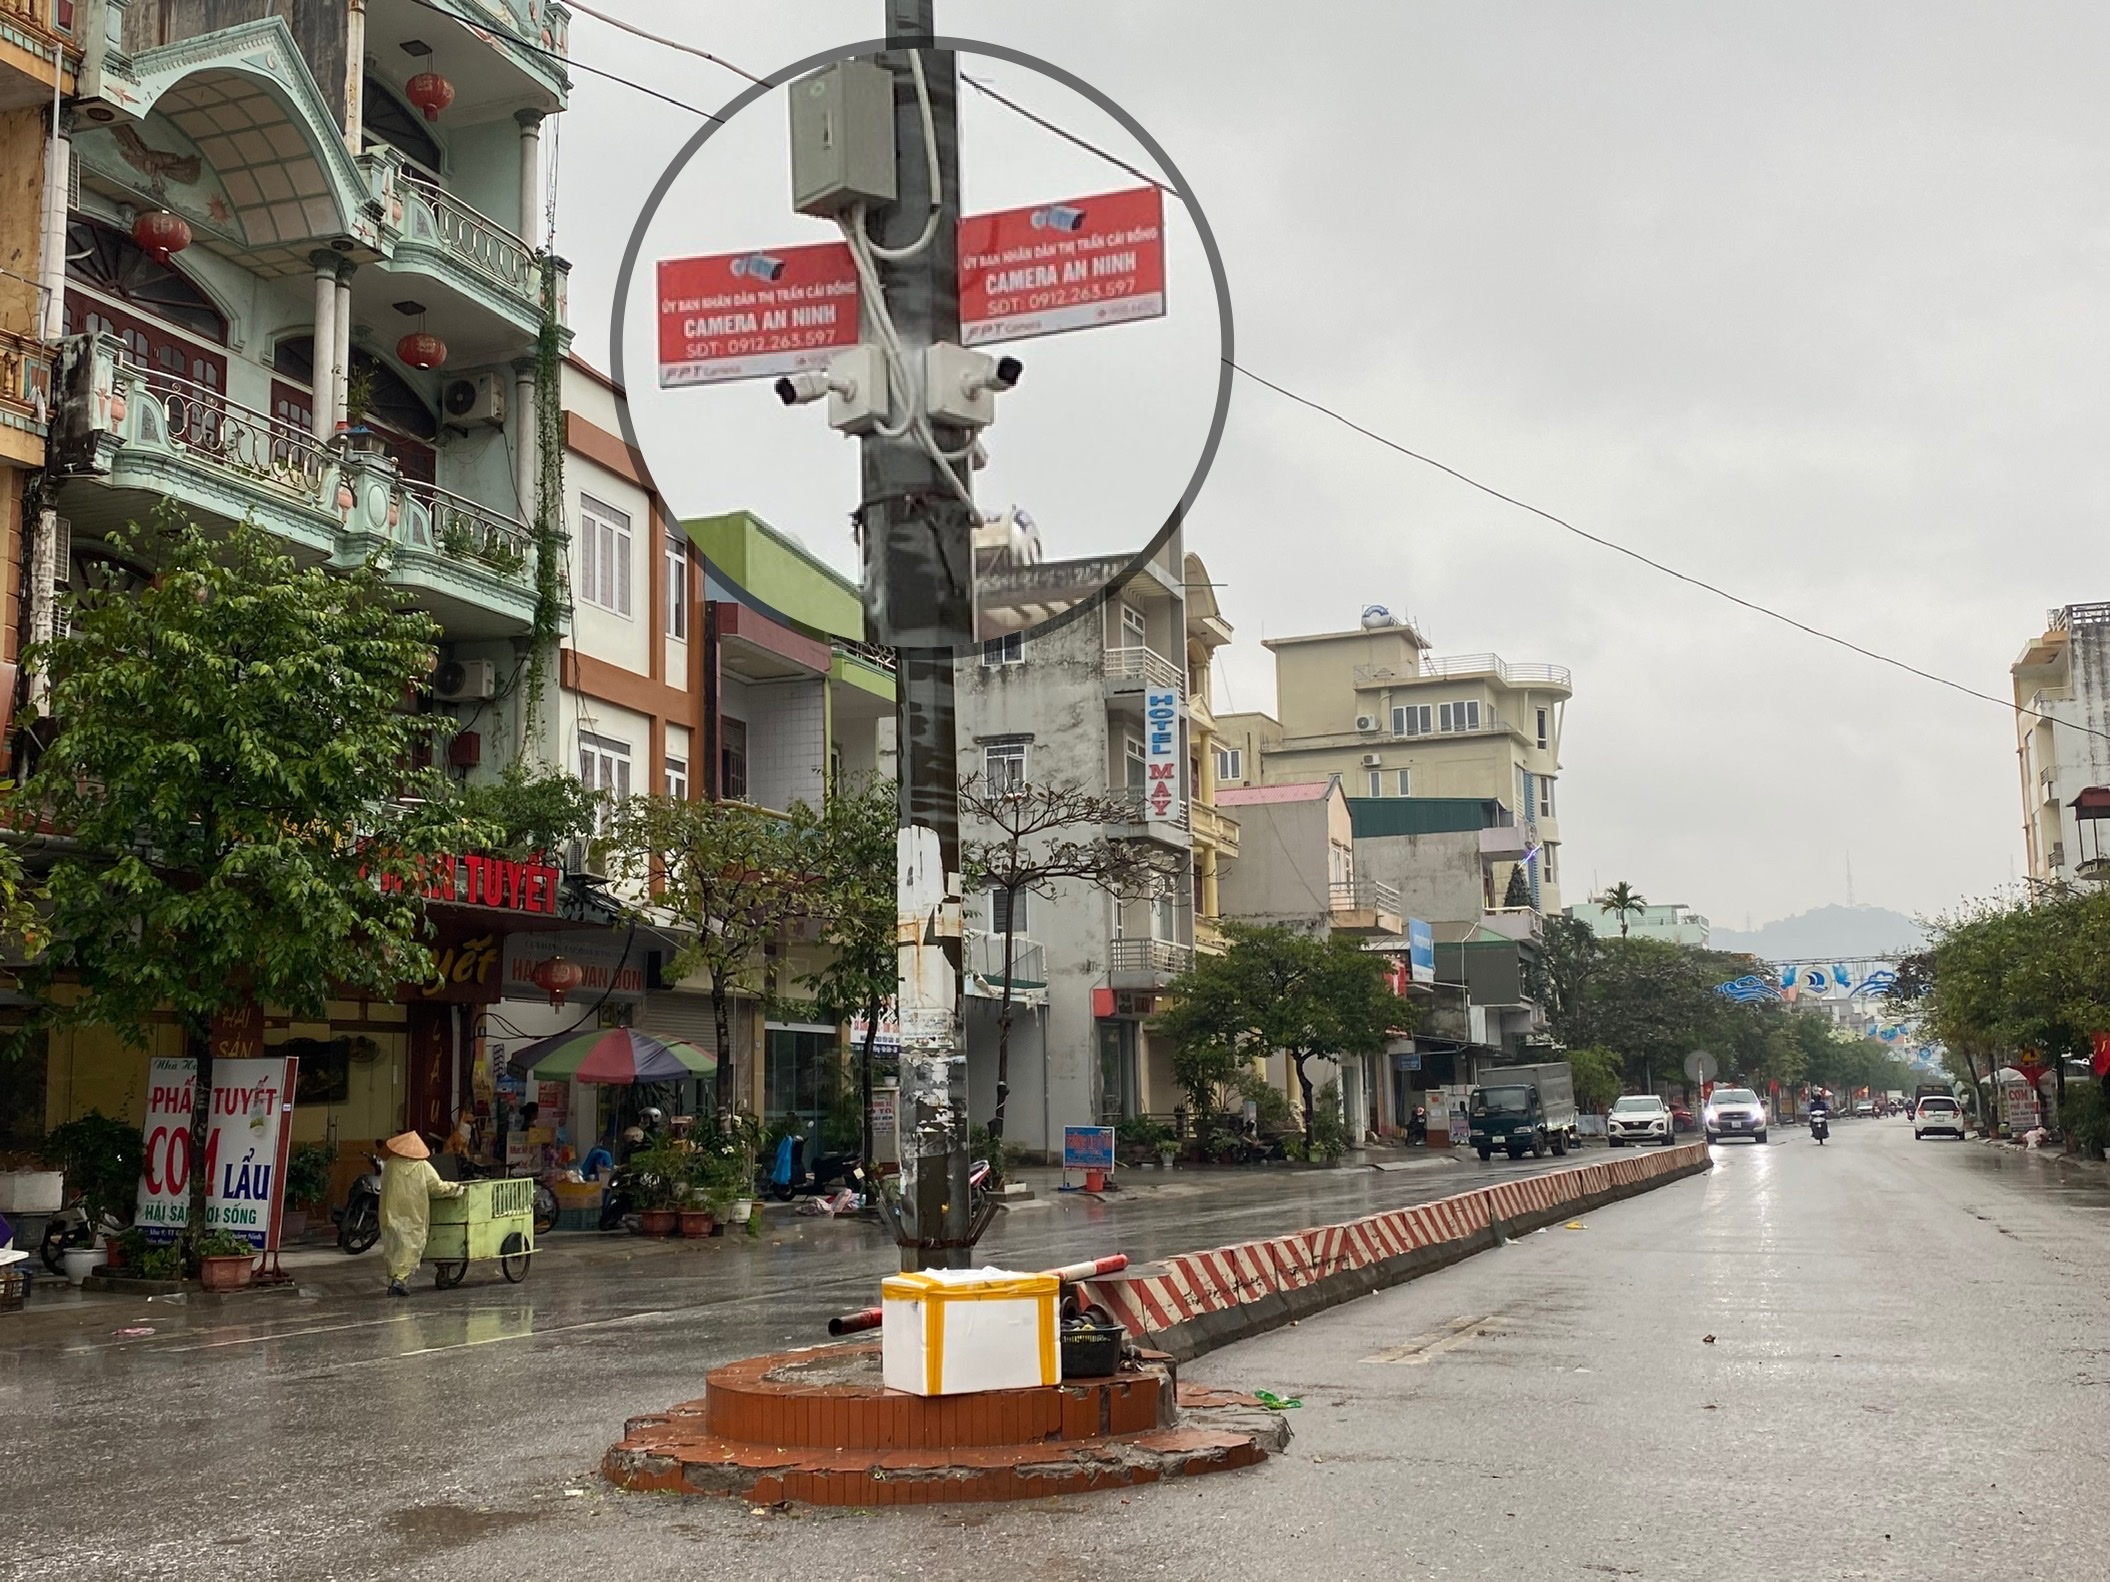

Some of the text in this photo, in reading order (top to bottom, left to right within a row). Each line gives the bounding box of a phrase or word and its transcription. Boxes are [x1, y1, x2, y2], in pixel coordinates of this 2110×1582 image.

[979, 254, 1000, 267] BAN
[986, 252, 1137, 294] CAMERA AN NINH
[680, 298, 700, 312] BAN
[684, 304, 837, 338] CAMERA AN NINH
[1149, 695, 1174, 816] HOTEL MAY
[464, 848, 560, 914] TUYẾT
[151, 1074, 277, 1116] PHẤ TUYẾT
[222, 1147, 272, 1201] LẨU
[145, 1200, 166, 1220] HẢI
[169, 1202, 189, 1223] SẢ
[223, 1203, 257, 1225] SỐNG
